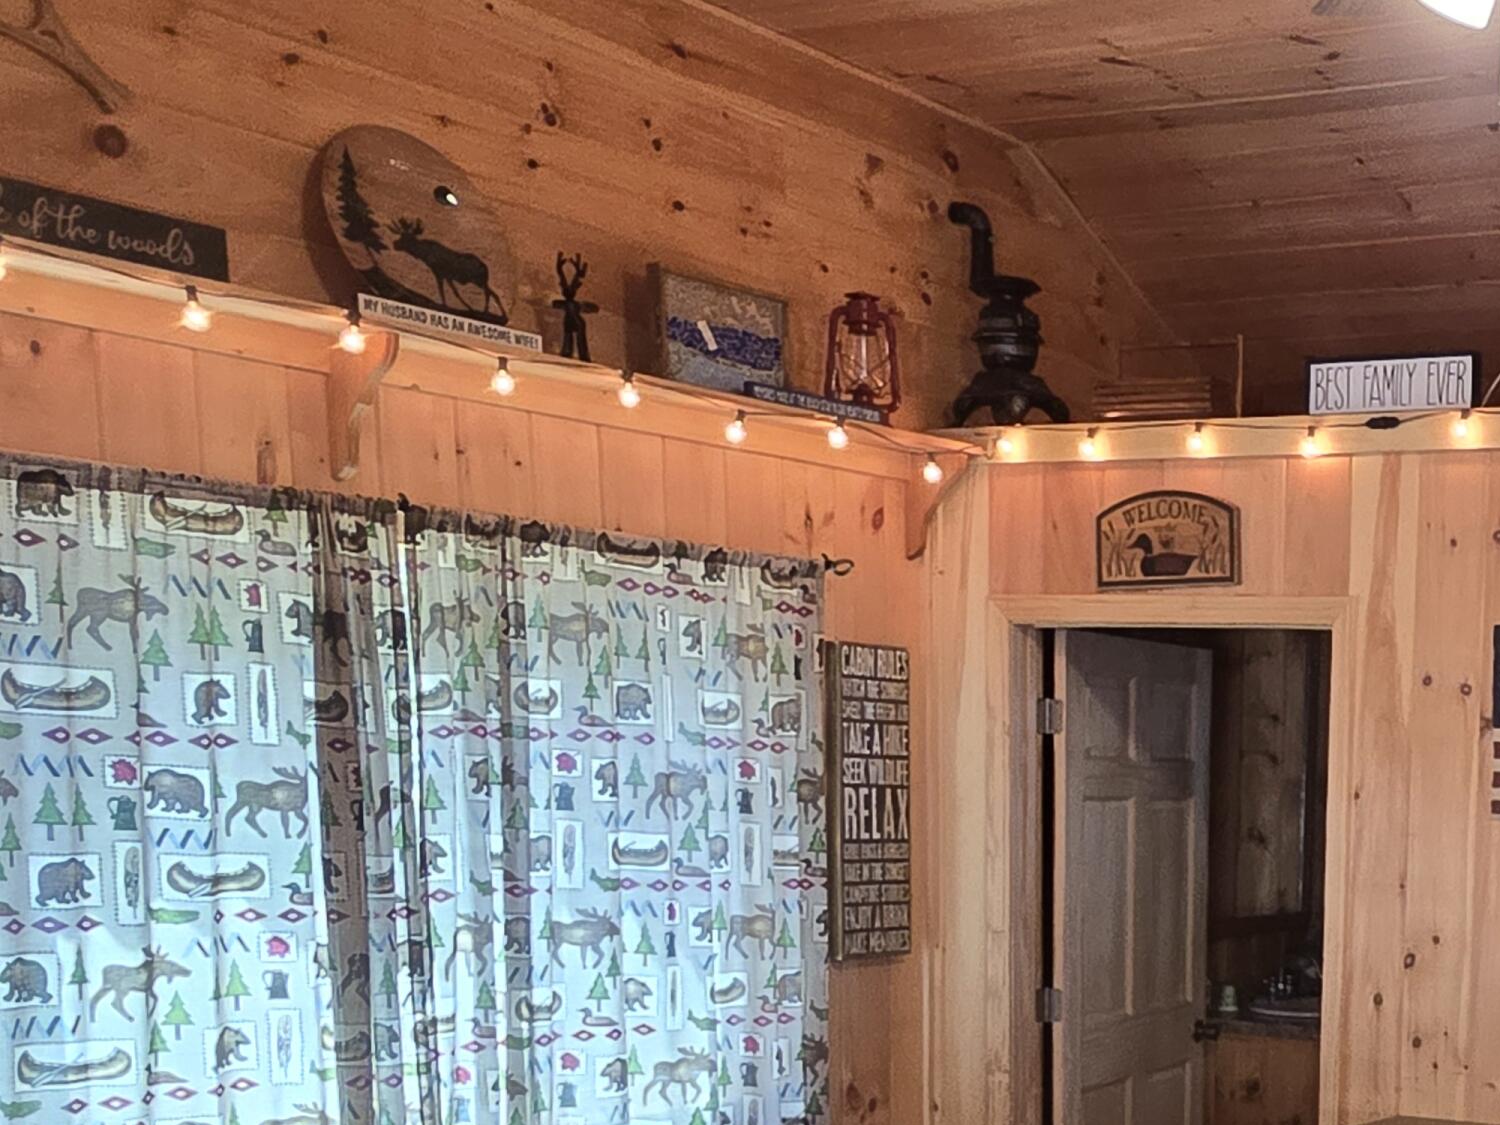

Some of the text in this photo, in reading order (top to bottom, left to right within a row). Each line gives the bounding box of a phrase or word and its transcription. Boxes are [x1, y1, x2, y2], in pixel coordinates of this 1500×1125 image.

[18, 197, 50, 238] of
[53, 203, 97, 243] the
[107, 227, 194, 265] woods
[363, 298, 539, 350] MY HUSBAND HAS AN AWESOME WIFE!
[1314, 359, 1467, 411] BEST FAMILY EVER
[1122, 499, 1208, 527] WELCOME
[841, 645, 908, 680] CABIN RULES
[842, 722, 908, 756] TAKE A HIKE
[843, 758, 909, 786] SEEK WILDLIFE
[844, 787, 909, 840] RELAX
[874, 905, 881, 928] A
